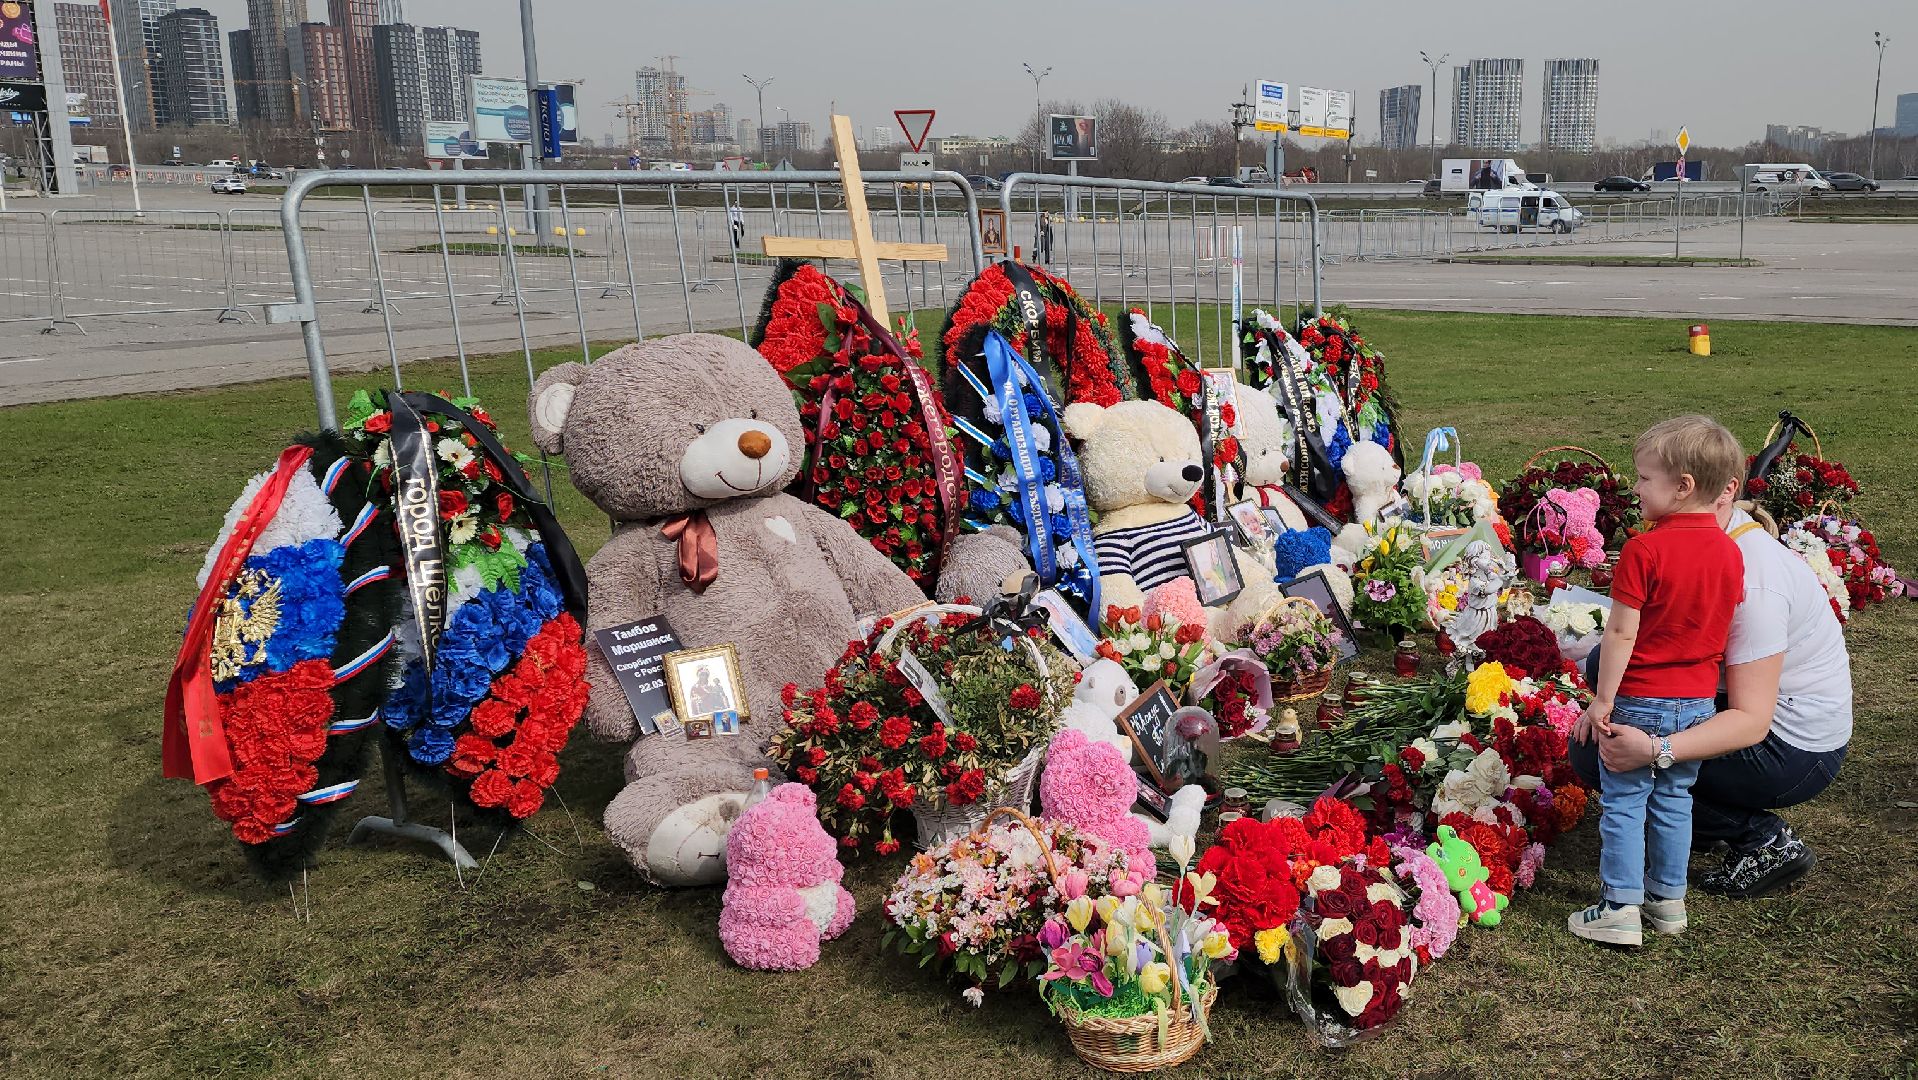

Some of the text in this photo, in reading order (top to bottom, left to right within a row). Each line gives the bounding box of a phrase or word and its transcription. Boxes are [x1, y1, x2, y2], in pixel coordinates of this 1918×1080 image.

[403, 480, 436, 551] город
[611, 623, 658, 641] Тамбов
[610, 633, 673, 656] Моршанск
[616, 657, 652, 673] Скорбит
[640, 665, 663, 678] Росс
